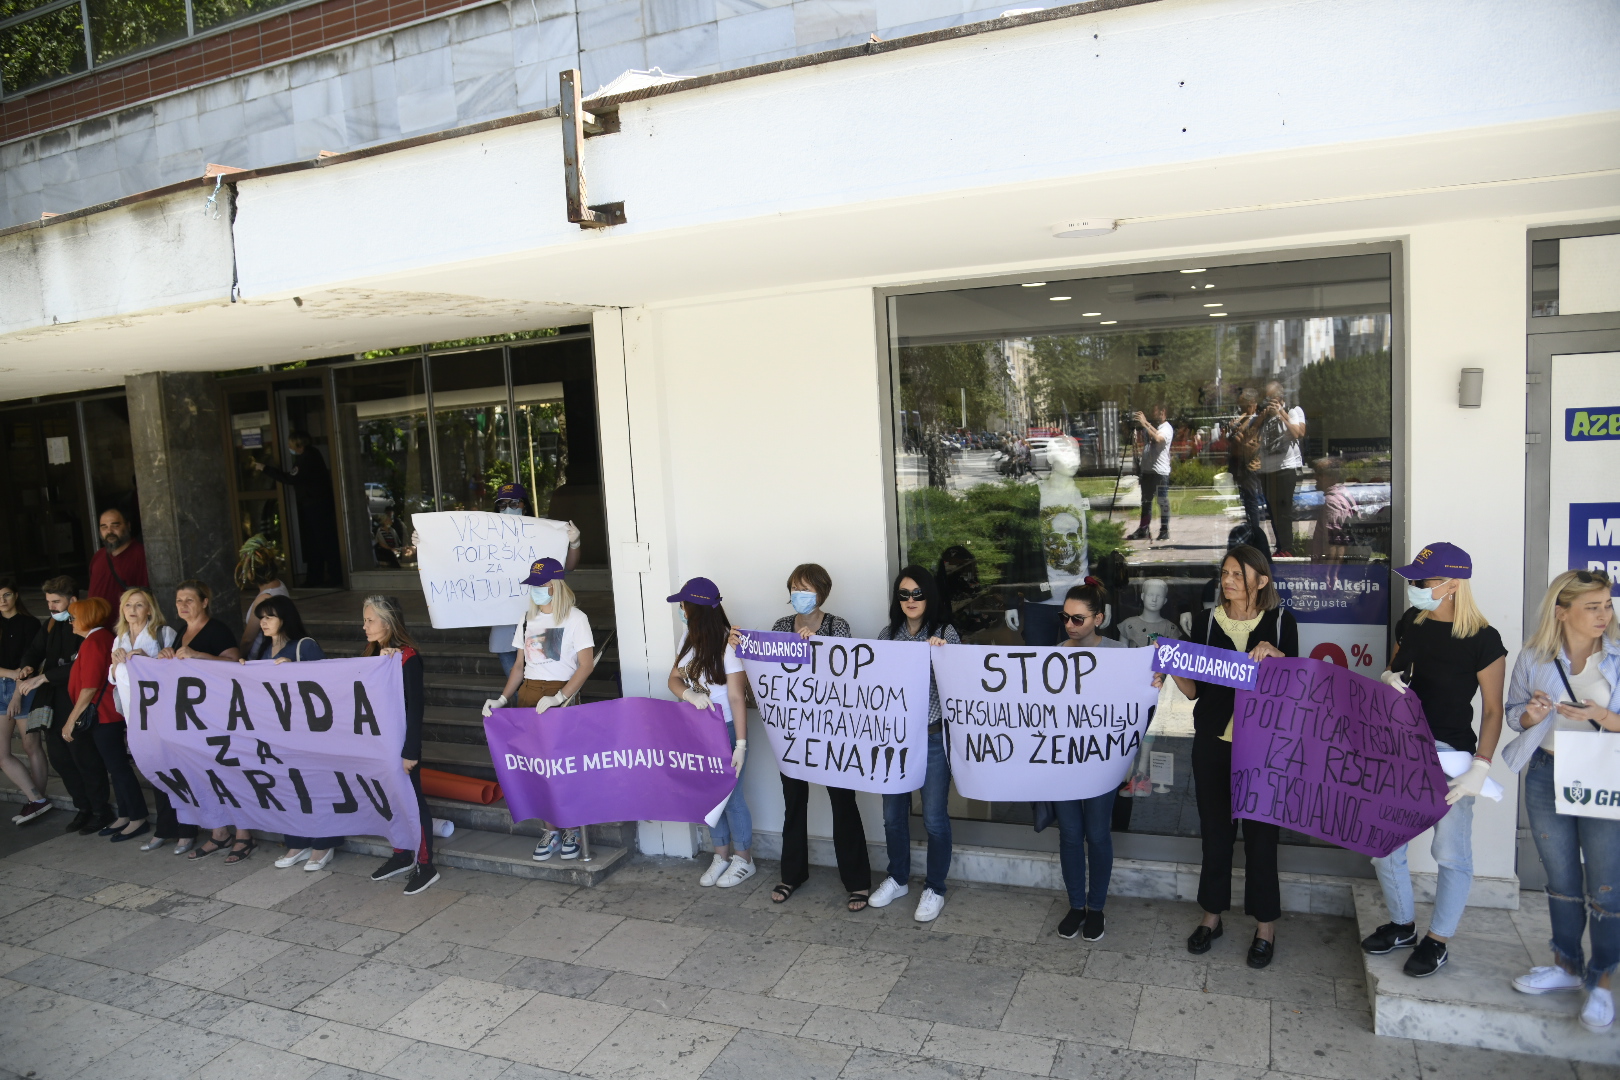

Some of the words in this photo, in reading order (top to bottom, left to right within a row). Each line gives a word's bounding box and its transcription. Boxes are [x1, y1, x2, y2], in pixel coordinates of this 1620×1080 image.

[453, 542, 537, 563] PODRŠKA
[485, 563, 504, 574] ZA
[1333, 579, 1380, 594] Akcija
[748, 641, 808, 658] SOLIDARNOST
[1172, 651, 1255, 682] SOLIDARNOST
[981, 651, 1097, 695] STOP
[1256, 666, 1335, 707] UDSKA
[138, 676, 382, 736] PRAVDA
[757, 674, 908, 712] SEKSUALNOM
[945, 697, 1058, 729] SEKSUALNOM
[206, 735, 284, 767] ZA
[505, 753, 577, 778] DEVOJKE
[583, 748, 665, 772] MENJAJU
[668, 750, 705, 772] SVET
[966, 732, 1014, 764] NAD
[1029, 729, 1140, 765] ŽENAMA
[1323, 745, 1435, 807] REŠETAKA
[154, 767, 394, 822] MARIJU
[1261, 771, 1372, 843] SEKSUALNOG
